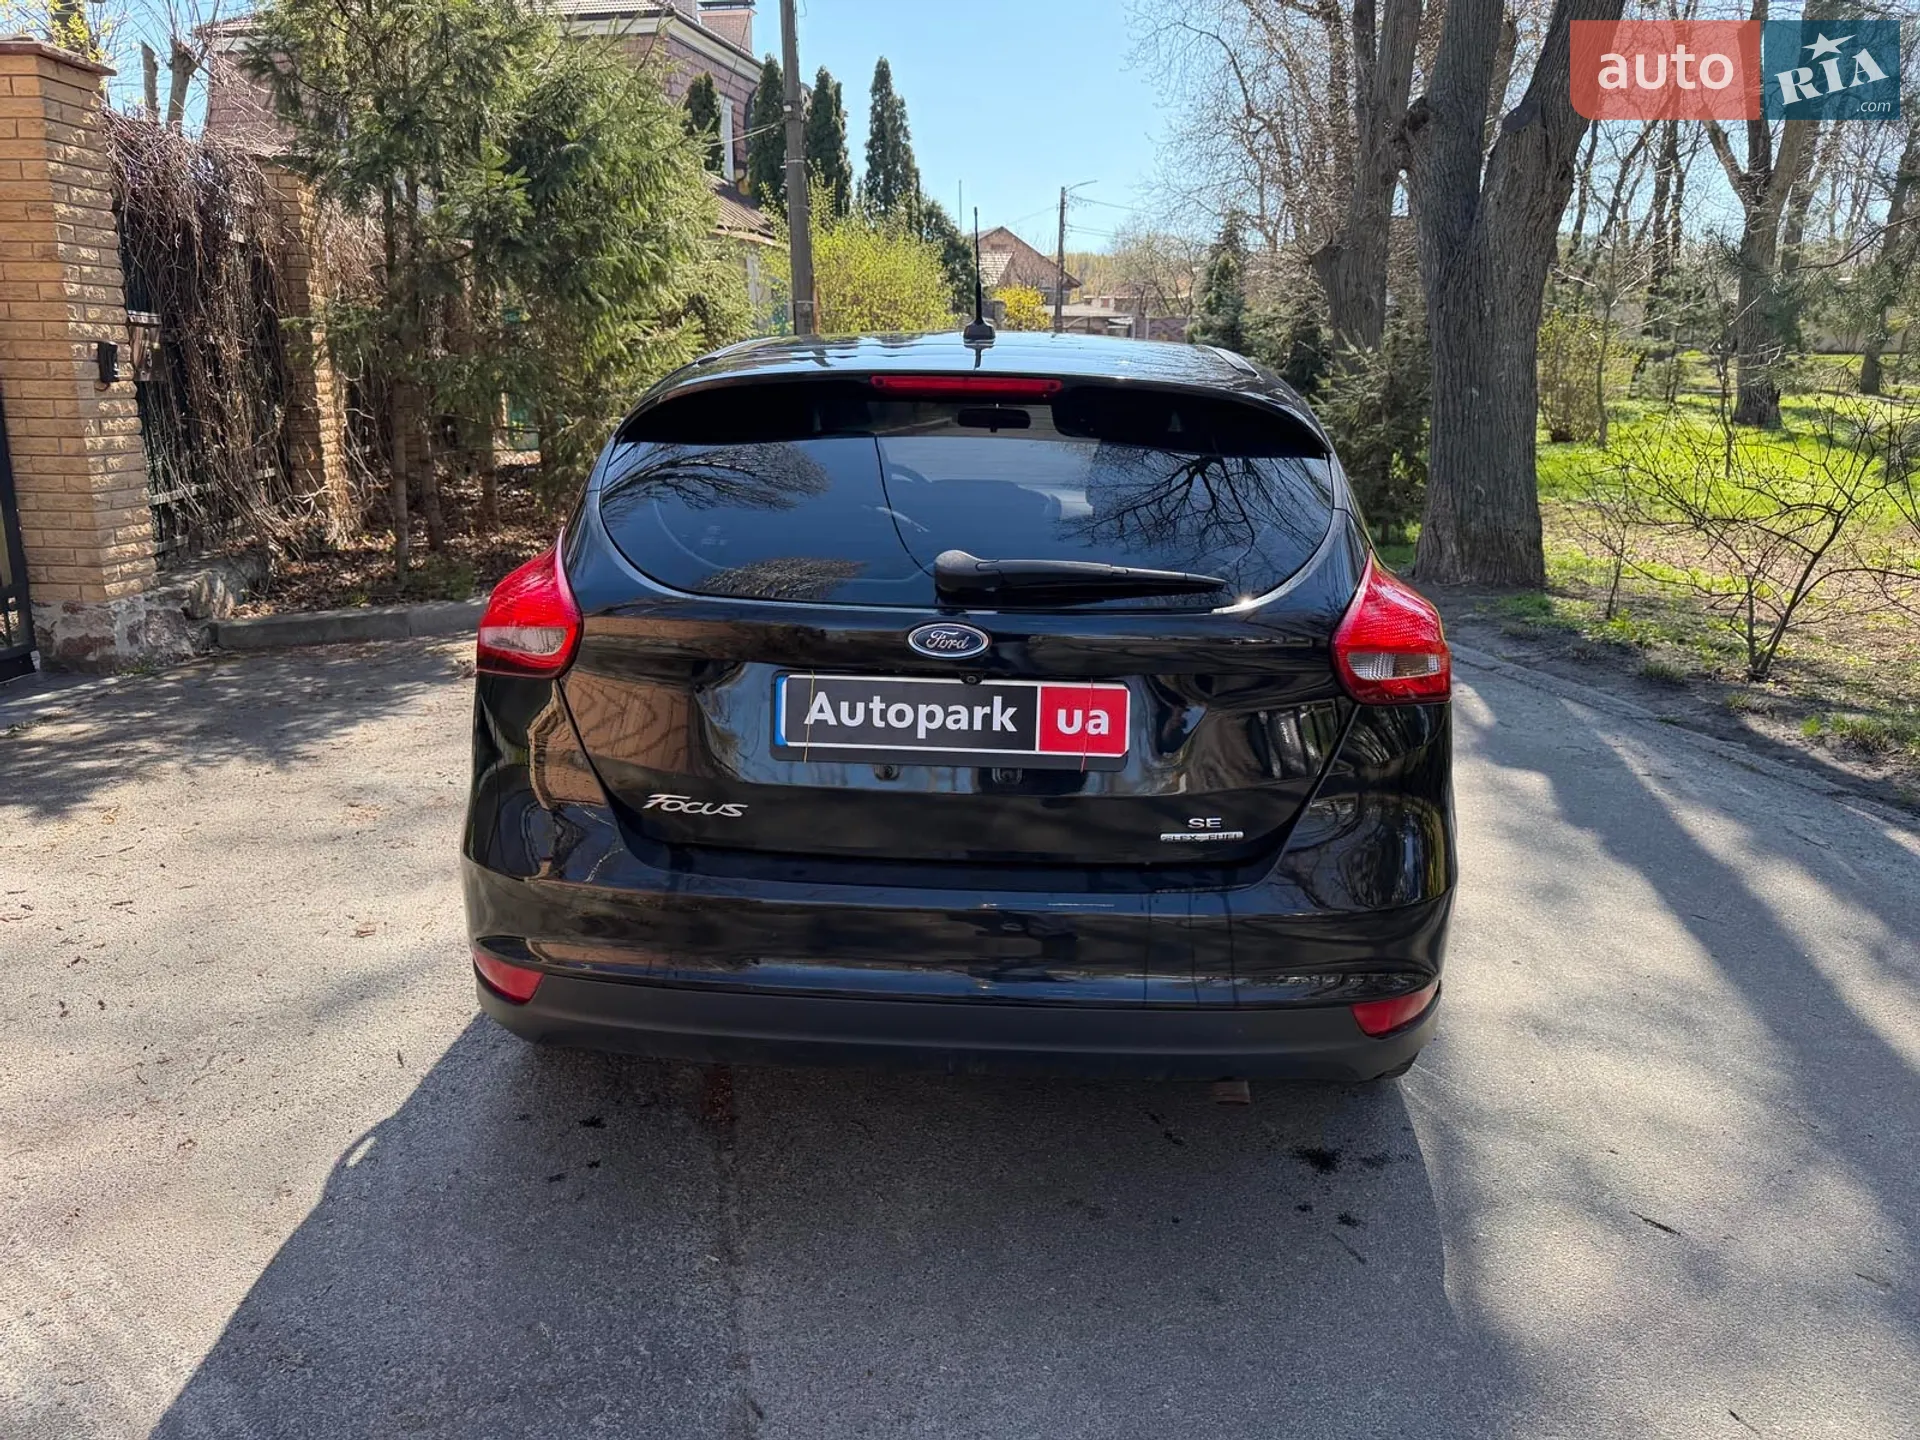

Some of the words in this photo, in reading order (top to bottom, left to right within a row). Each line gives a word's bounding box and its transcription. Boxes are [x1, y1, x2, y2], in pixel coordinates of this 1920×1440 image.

[926, 630, 970, 649] Ford
[804, 691, 1018, 739] Autopark
[1057, 708, 1109, 735] ua
[1187, 817, 1222, 829] SE
